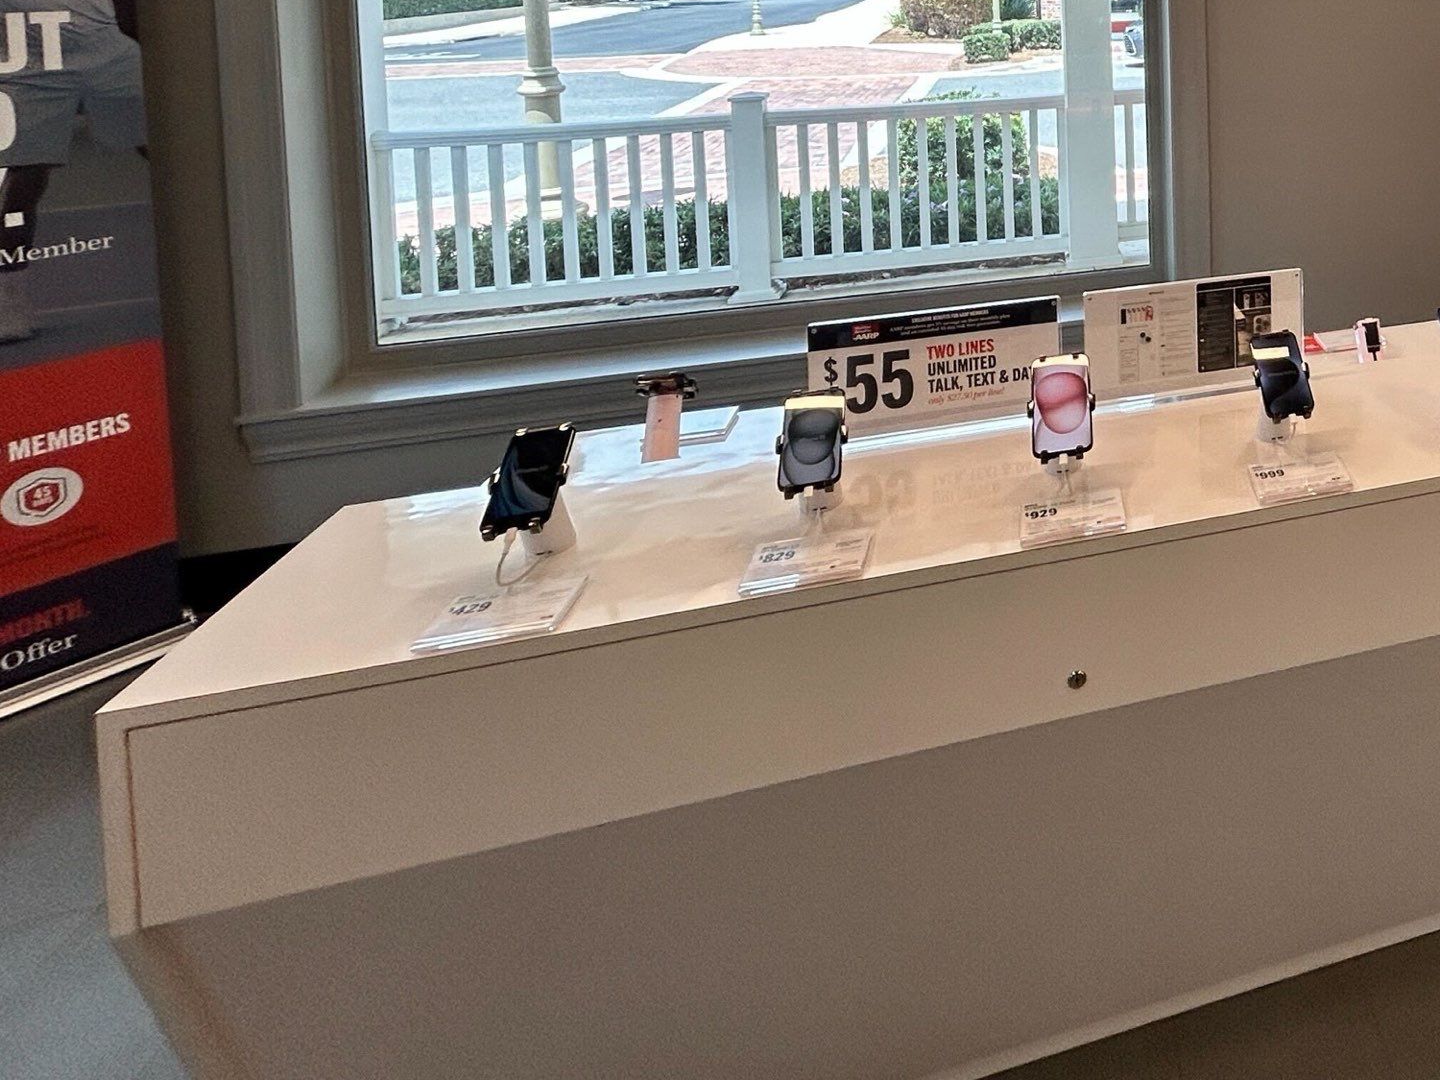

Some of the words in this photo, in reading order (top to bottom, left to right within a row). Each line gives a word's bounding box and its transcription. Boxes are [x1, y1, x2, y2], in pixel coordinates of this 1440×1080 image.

[0, 236, 114, 266] Member
[927, 344, 955, 360] TWO
[959, 339, 995, 356] LINES
[928, 355, 997, 376] UNLIMITED
[928, 376, 964, 393] TALK,
[967, 371, 997, 388] TEXT
[999, 369, 1009, 383] &
[8, 413, 131, 462] MEMBERS
[0, 633, 78, 671] Offer
